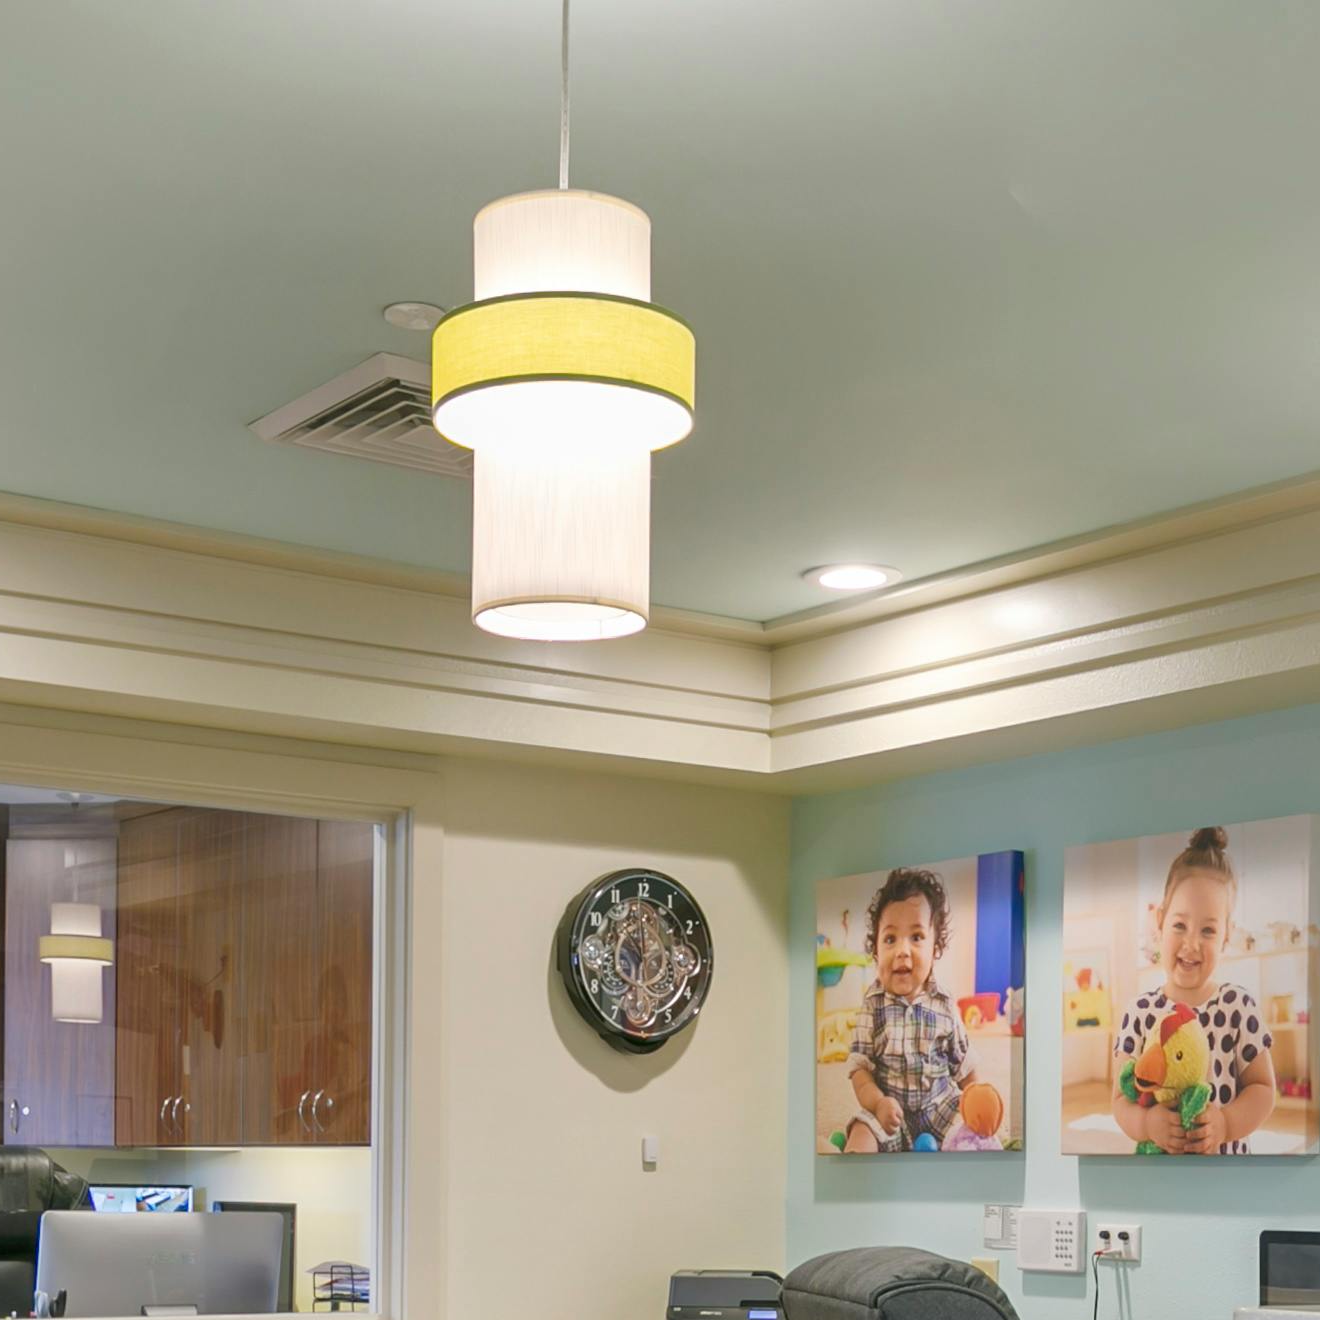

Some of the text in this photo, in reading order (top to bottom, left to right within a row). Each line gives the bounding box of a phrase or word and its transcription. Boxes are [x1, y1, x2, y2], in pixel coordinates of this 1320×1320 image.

[611, 889, 621, 904] 11
[637, 882, 650, 898] 12
[667, 894, 673, 909] 1
[590, 911, 602, 927] 10
[685, 919, 694, 935] 2
[590, 978, 599, 994] 8
[683, 985, 692, 1000] 4
[611, 1005, 619, 1020] 7
[664, 1009, 673, 1024] 5
